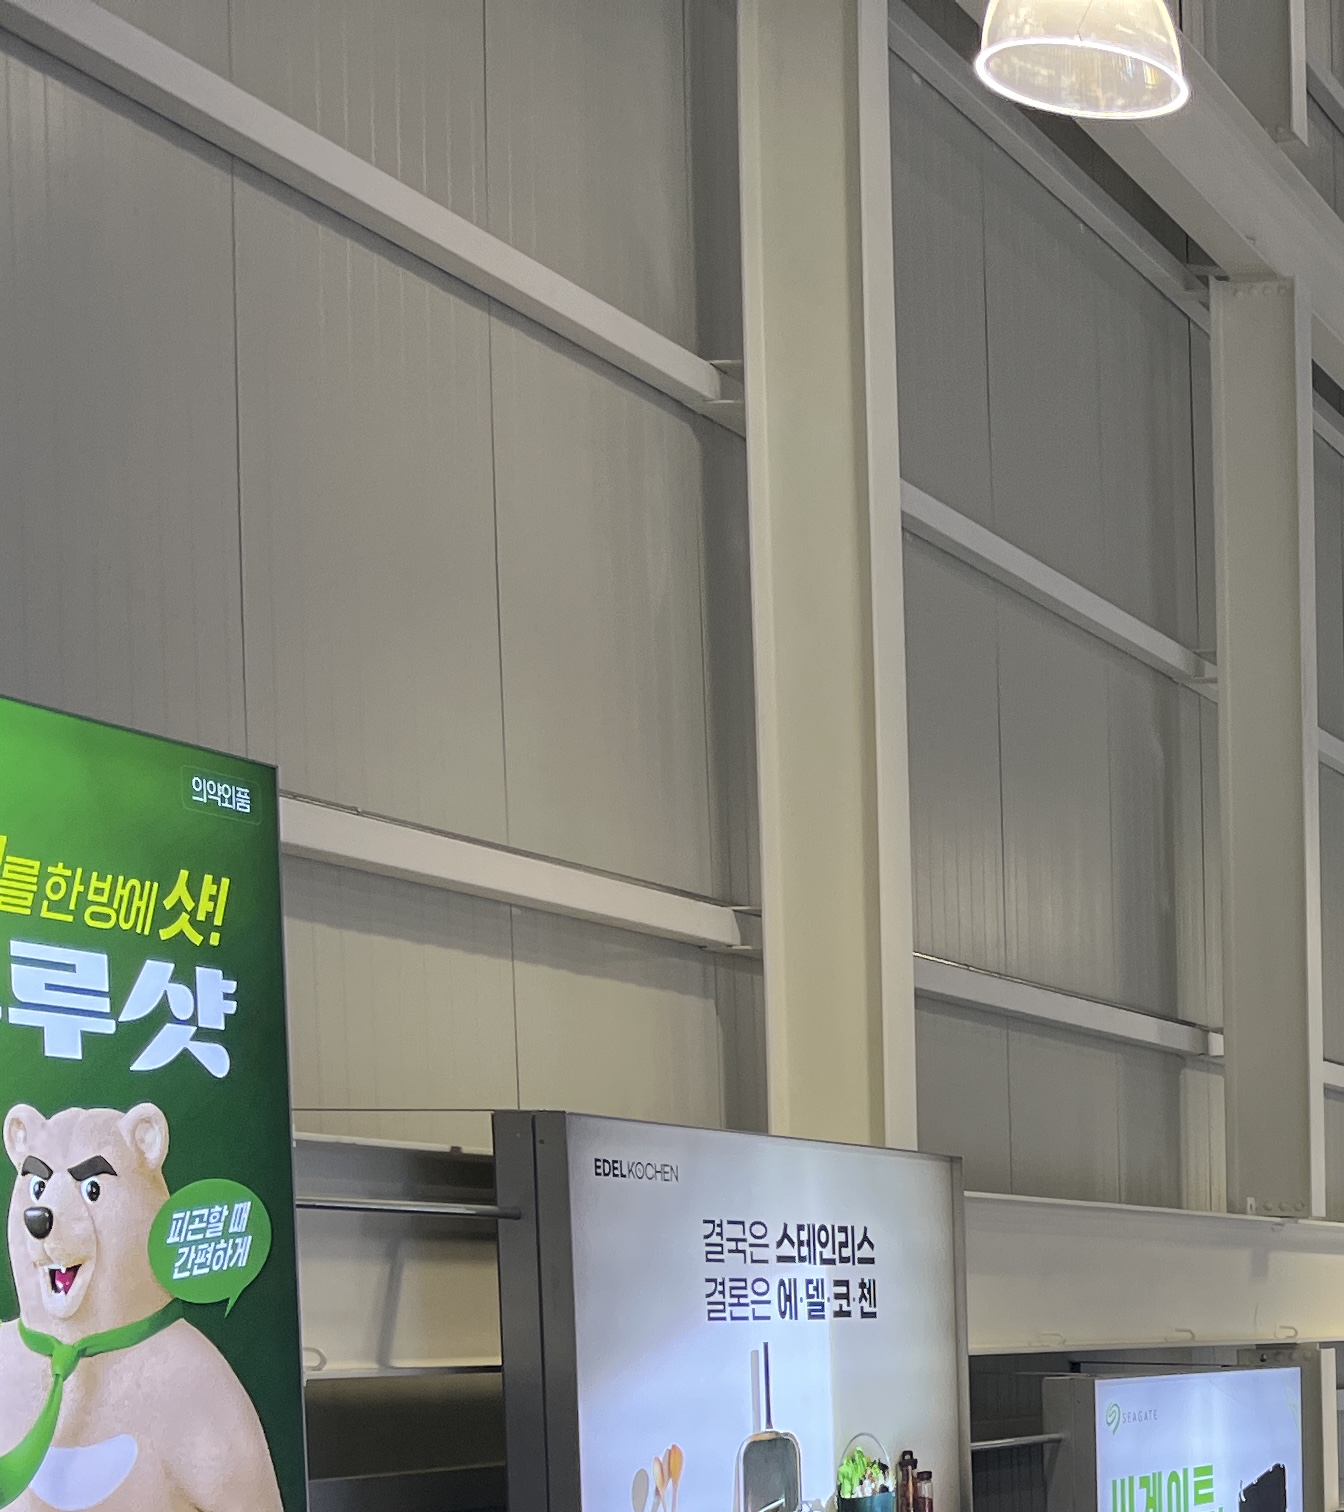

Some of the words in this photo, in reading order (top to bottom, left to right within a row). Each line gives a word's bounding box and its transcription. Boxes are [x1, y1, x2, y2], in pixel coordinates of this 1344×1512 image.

[191, 775, 251, 814] 의약외품
[158, 869, 231, 947] 샷!
[0, 939, 238, 1079] 루샷
[594, 1157, 680, 1183] EDELKOCHEN
[166, 1204, 229, 1245] 피곤할
[228, 1201, 252, 1234] 때
[702, 1218, 771, 1266] 결국은
[775, 1221, 876, 1267] 스테인리스
[172, 1235, 253, 1280] 간편하게
[704, 1276, 772, 1322] 결론은
[1122, 1409, 1159, 1424] SEAGATE
